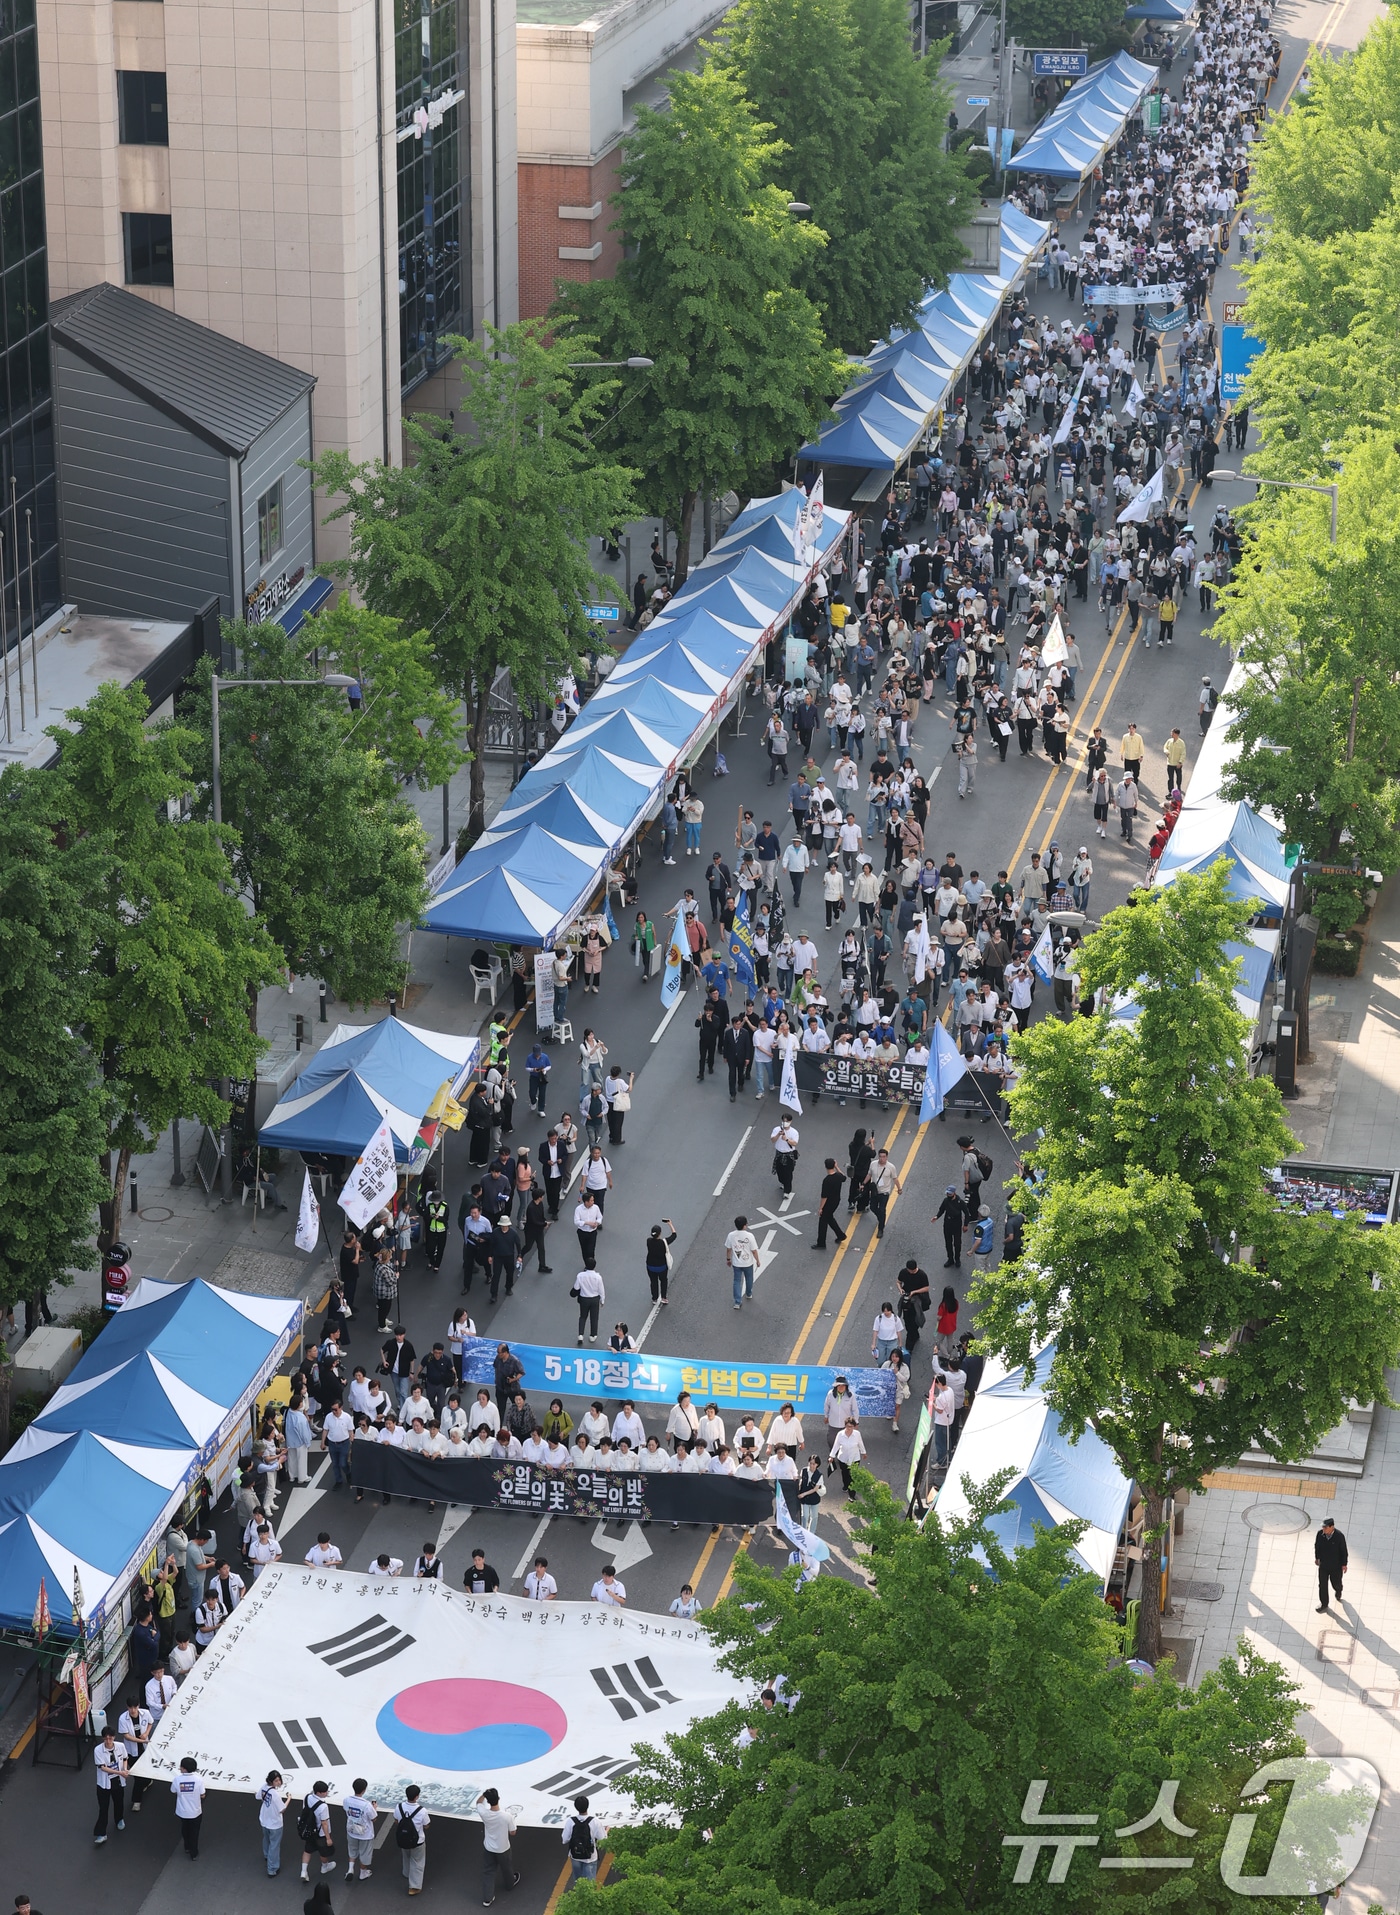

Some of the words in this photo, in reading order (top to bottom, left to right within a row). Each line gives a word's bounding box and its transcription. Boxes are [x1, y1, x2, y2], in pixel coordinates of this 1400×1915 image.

[1042, 55, 1080, 65] 광주일보
[825, 1060, 863, 1089] 오월의
[865, 1073, 882, 1097] 꽃,
[887, 1065, 925, 1096] 오늘의
[544, 1354, 667, 1393] 5·18정신,
[680, 1365, 808, 1402] 헌법으로!
[500, 1465, 546, 1501] 오월의
[549, 1480, 569, 1511] 꽃,
[577, 1473, 623, 1507] 오늘의
[626, 1478, 642, 1507] 빛
[507, 1499, 526, 1507] FLOWERS
[465, 1600, 508, 1620] 김창숙
[521, 1611, 565, 1625] 백정기
[580, 1612, 625, 1629] 장준하
[638, 1623, 700, 1642] 김마리아
[151, 1757, 251, 1782] 민족제연구소
[187, 1750, 223, 1764] 이육사
